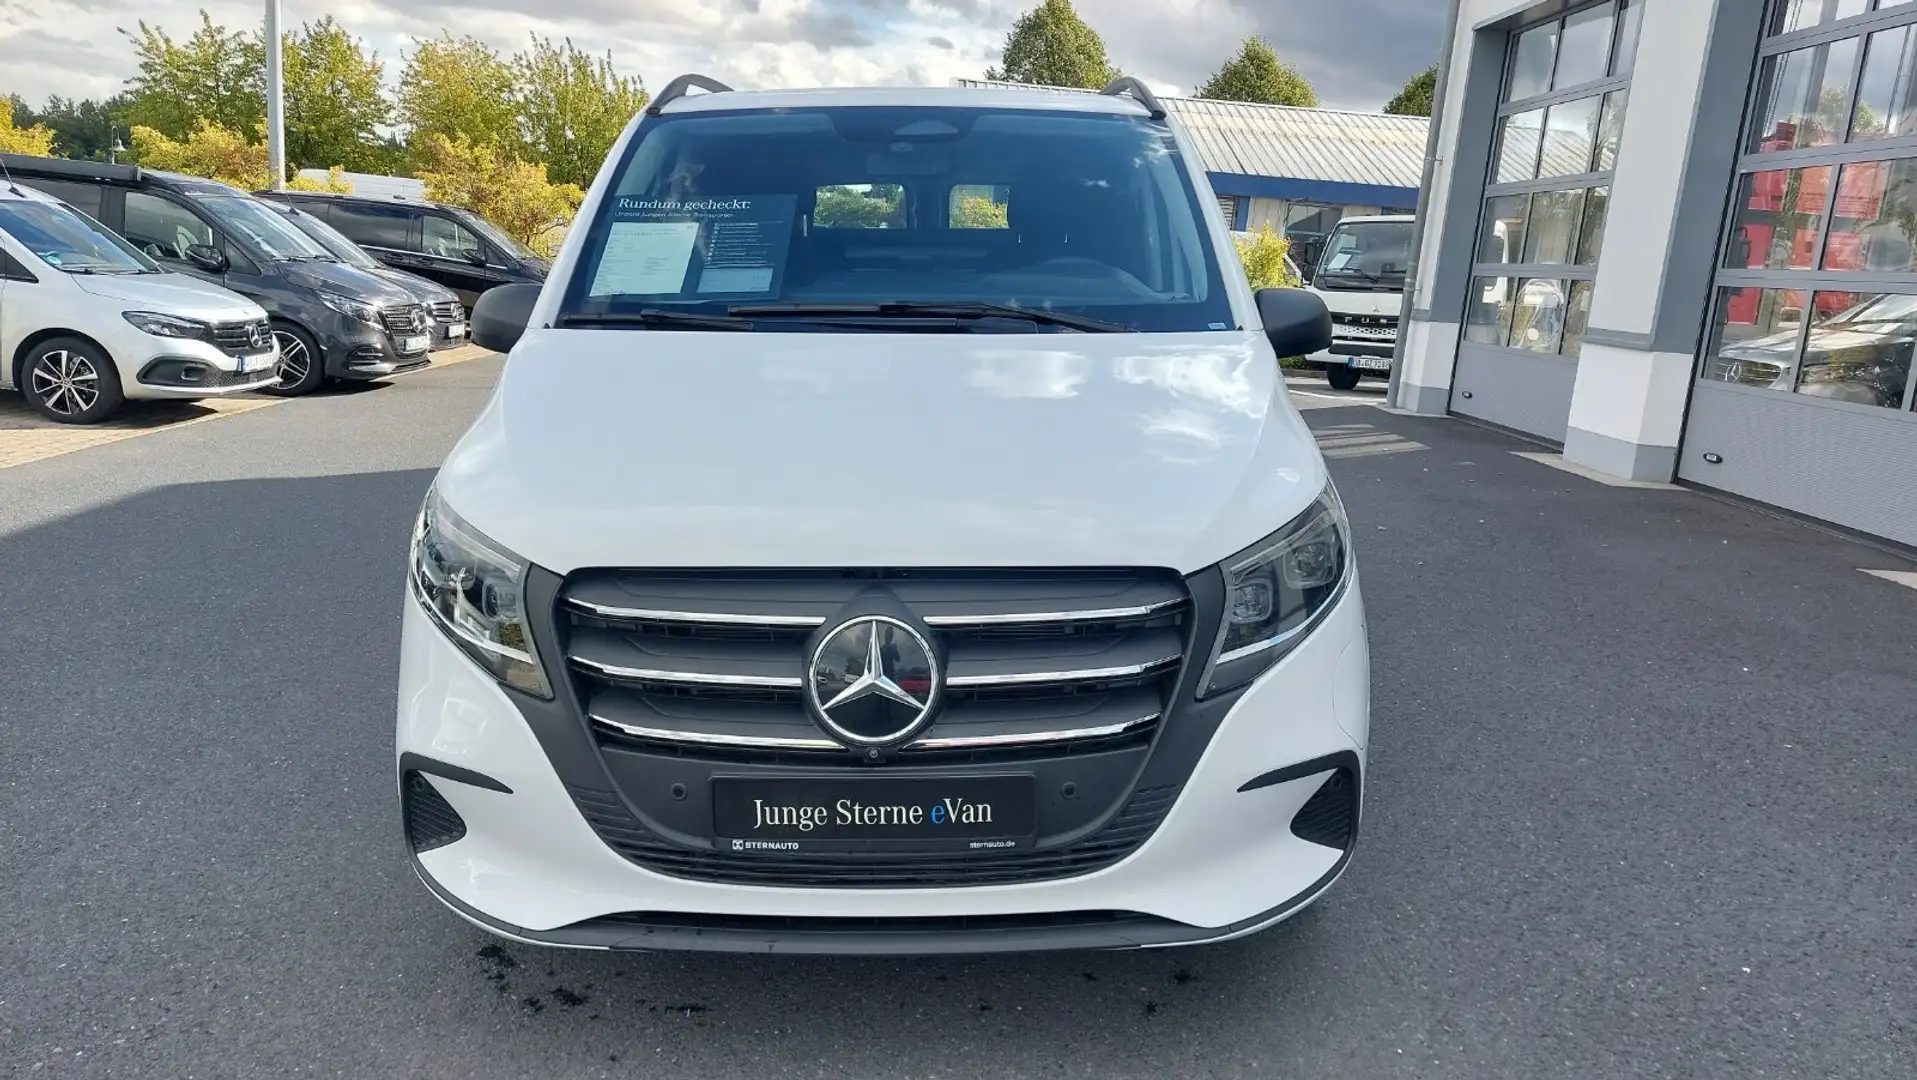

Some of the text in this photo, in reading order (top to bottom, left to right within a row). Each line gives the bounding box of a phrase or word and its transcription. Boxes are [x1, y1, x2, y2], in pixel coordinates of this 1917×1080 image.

[619, 198, 752, 211] Rundum gecheckt:
[753, 798, 993, 832] Junge Sterne eVan
[745, 841, 799, 850] STERNAUTO
[969, 840, 1016, 849] sternauto.de
